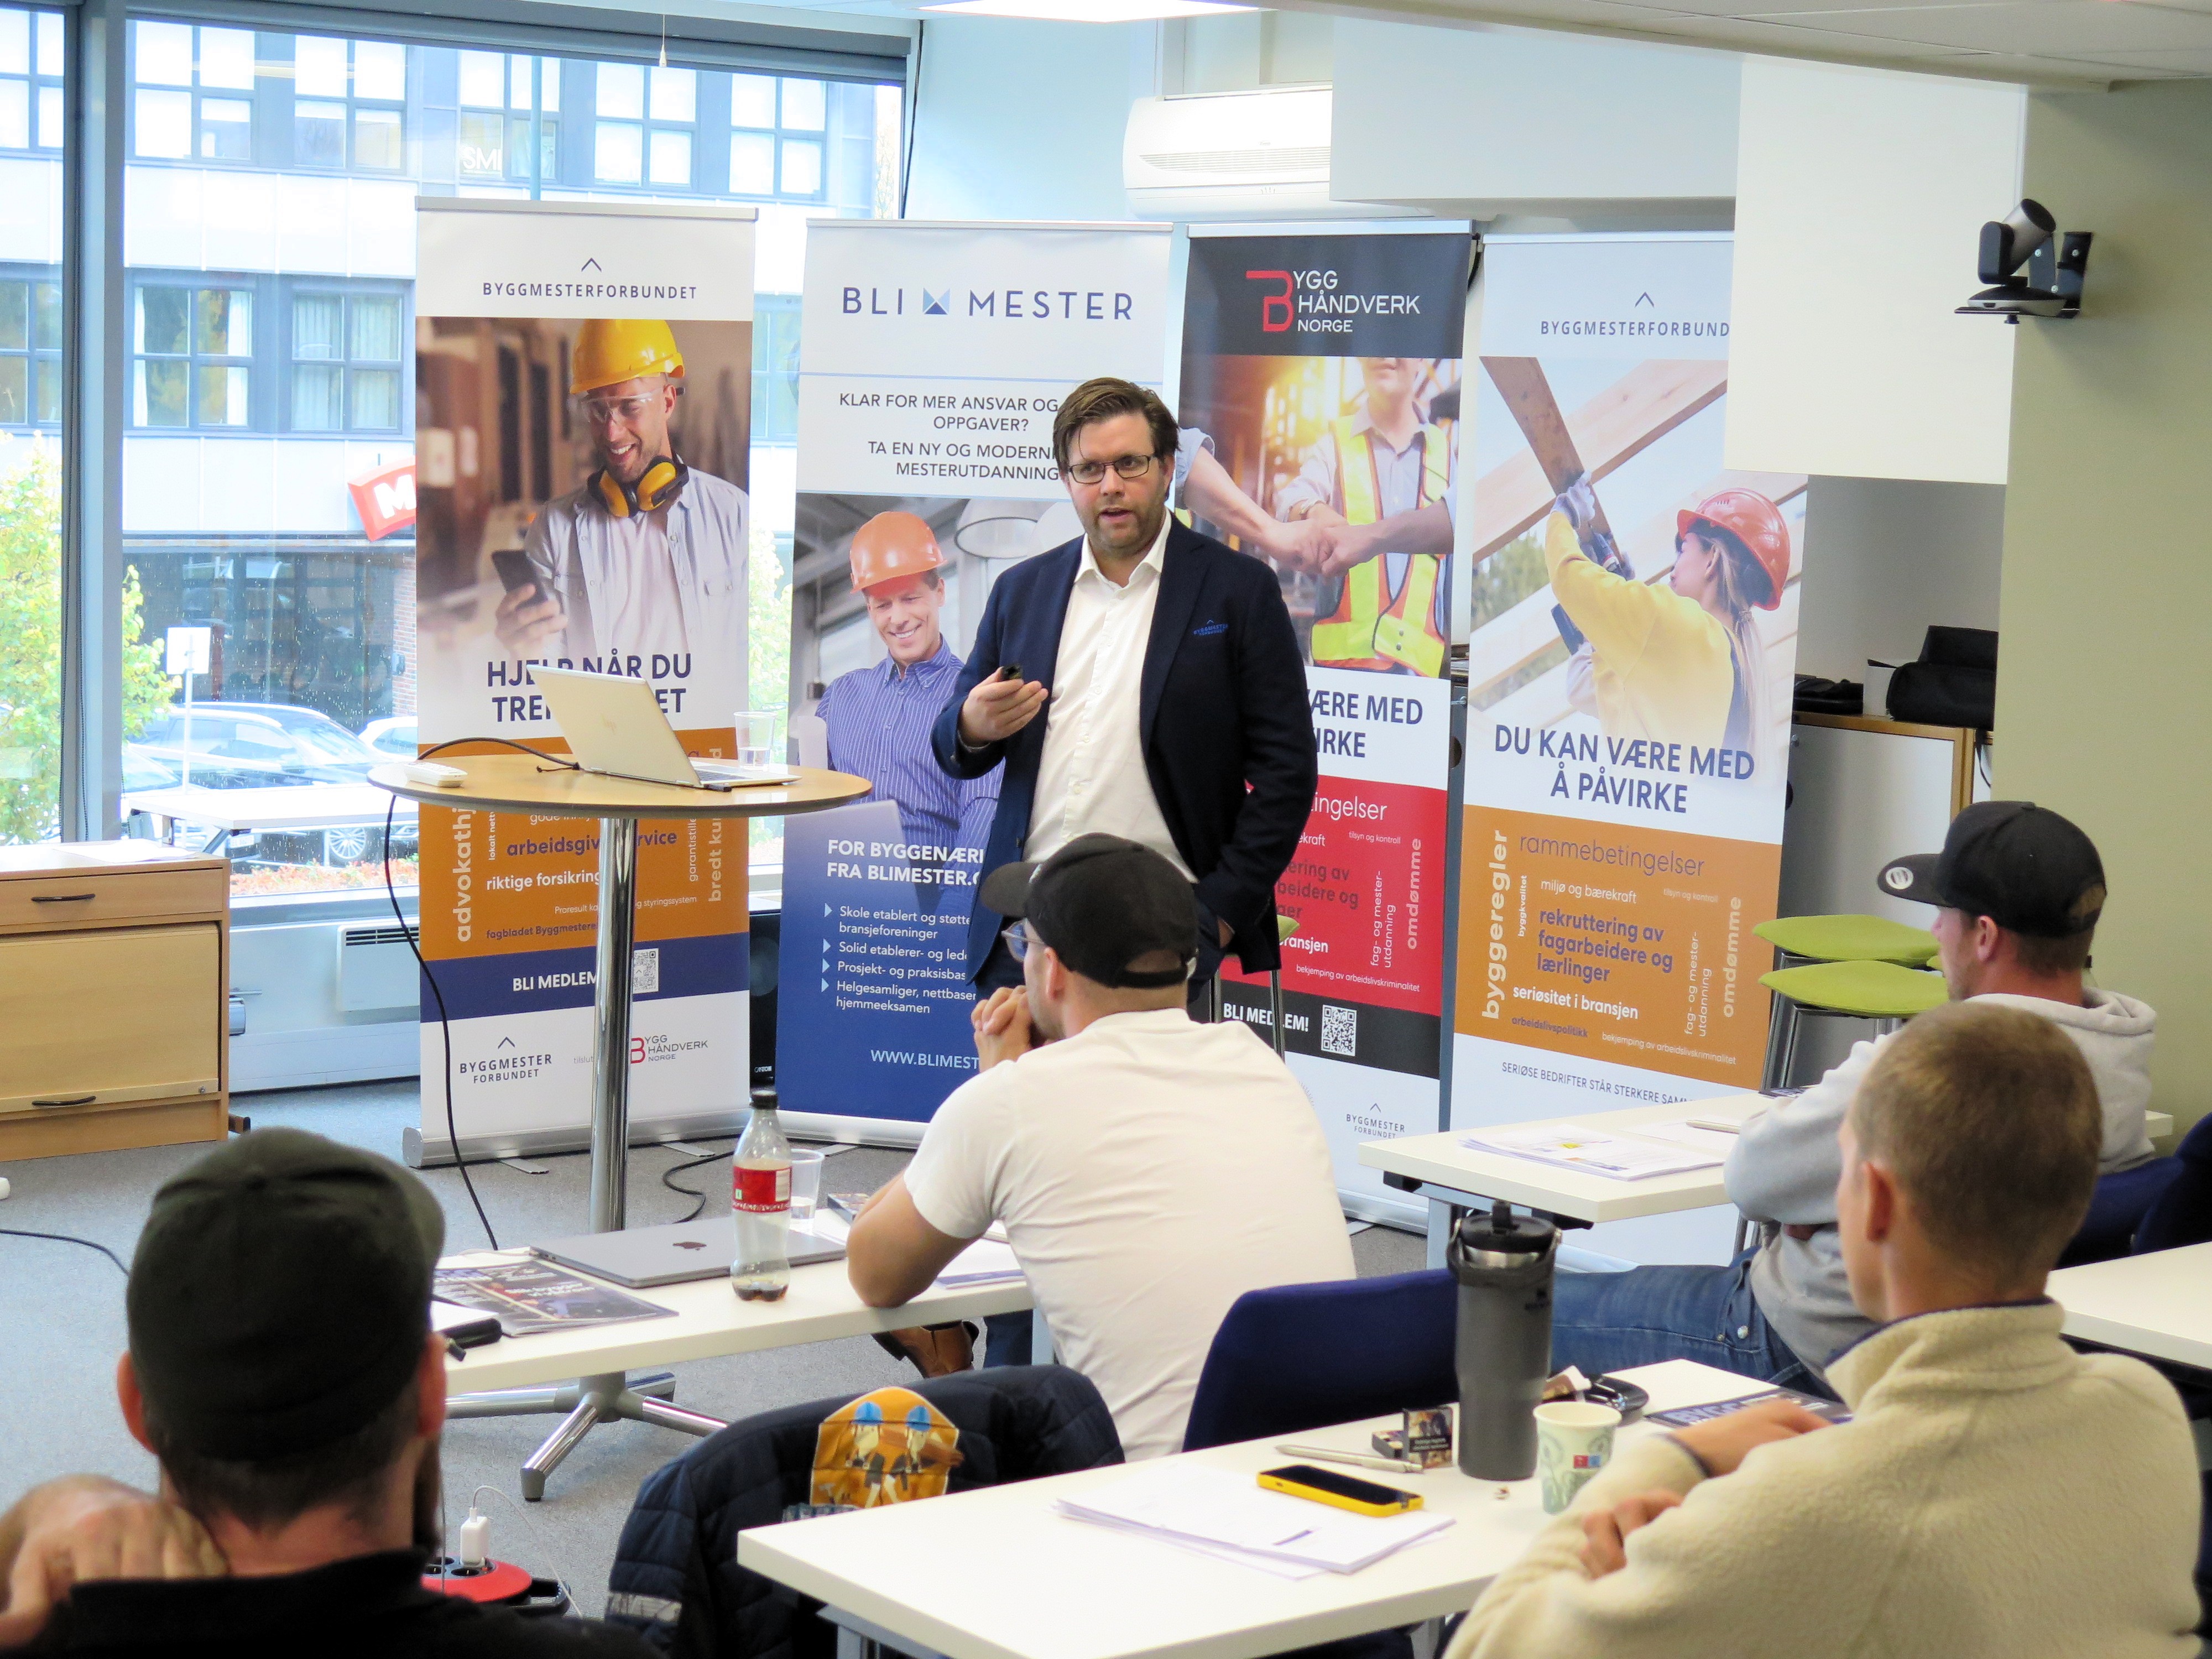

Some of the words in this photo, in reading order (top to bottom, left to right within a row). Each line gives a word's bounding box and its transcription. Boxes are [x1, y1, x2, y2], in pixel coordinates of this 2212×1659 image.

[483, 282, 697, 299] BYGGMESTERFORBUNDET
[843, 287, 903, 315] BLI
[969, 289, 1133, 320] MESTER
[1298, 290, 1420, 314] HÅNDVERK
[1297, 319, 1353, 332] NORGE
[1541, 321, 1729, 337] BYGGMESTERFORBUND
[839, 393, 880, 408] KLAR
[886, 394, 917, 409] FOR
[924, 395, 956, 410] MER
[961, 397, 1027, 411] ANSVAR
[1032, 398, 1058, 412] OG
[933, 416, 1029, 431] OPPGAVER?
[868, 441, 886, 454] TA
[893, 443, 914, 455] EN
[920, 443, 941, 456] NY
[946, 444, 971, 457] OG
[896, 462, 1059, 481] MESTERUTDANNING
[652, 653, 691, 680] DU
[1307, 689, 1359, 719] ÆRE
[1366, 695, 1423, 726] MED
[1496, 724, 1530, 755] DU
[1540, 729, 1598, 763] KAN
[1607, 736, 1682, 773] VÆRE
[1689, 745, 1755, 780] MED
[1550, 761, 1569, 799] Å
[1578, 766, 1688, 813] PÅVIRKE
[1311, 792, 1387, 821] ingelser
[1349, 831, 1364, 841] tilsyn
[1366, 834, 1374, 843] og
[1376, 833, 1401, 844] kontroll
[828, 839, 864, 856] FOR
[1520, 834, 1705, 877] rammebetingelser
[708, 849, 722, 902] bredt
[827, 862, 862, 879] FRA
[1332, 867, 1349, 880] av
[487, 875, 533, 891] riktige
[1541, 878, 1566, 895] miljø
[1568, 885, 1582, 899] og
[1584, 886, 1637, 905] bærekraft
[1339, 891, 1359, 910] og
[1374, 870, 1383, 917] mester-
[1406, 838, 1421, 950] omdømme
[1663, 888, 1681, 900] tilsyn
[1682, 891, 1691, 901] og
[1693, 891, 1718, 902] kontroll
[555, 904, 587, 914] Proresult
[644, 896, 697, 907] styringssystem
[1518, 875, 1527, 937] byggkvalitet
[839, 906, 870, 919] Skole
[873, 909, 917, 922] etablert
[921, 914, 936, 925] og
[1482, 830, 1511, 1019] byggeregler
[1540, 908, 1639, 942] rekruttering
[1642, 926, 1665, 941] av
[487, 927, 533, 940] fagbladet
[535, 922, 599, 937] Byggmestere
[839, 922, 938, 941] bransjeforeninger
[1374, 920, 1383, 937] og
[1383, 905, 1396, 968] utdanning
[839, 942, 867, 954] Solid
[870, 945, 924, 958] etablerer-
[927, 950, 943, 962] og
[1538, 930, 1647, 965] fagarbeidere
[1651, 952, 1673, 973] og
[1689, 931, 1698, 983] mester-
[1723, 897, 1742, 1018] omdømme
[838, 961, 886, 975] Prosjekt-
[889, 966, 904, 977] og
[1296, 964, 1334, 980] bekjemping
[1345, 973, 1420, 992] arbeidslivskriminalitet
[1537, 953, 1610, 984] lærlinger
[513, 978, 534, 992] BLI
[539, 971, 596, 989] MEDLEM
[1513, 985, 1571, 1007] seriøsitet
[1574, 994, 1578, 1008] i
[1581, 995, 1639, 1020] bransjen
[1688, 985, 1697, 1003] og
[1699, 968, 1712, 1037] utdanning
[836, 995, 930, 1013] hjemmeeksamen
[1223, 1003, 1244, 1020] BLI
[1246, 1006, 1309, 1032] MEDEM!
[1512, 1016, 1588, 1038] arbeidslivspolitikk
[648, 1040, 708, 1053] HÅNDVERK
[1602, 1032, 1644, 1048] bekjemping
[1646, 1041, 1655, 1050] av
[1657, 1042, 1736, 1065] arbeidslivskriminalitet
[460, 1054, 552, 1073] BYGGMESTER
[648, 1053, 676, 1062] NORGE
[871, 1050, 979, 1069] WWW.BLIMEST
[473, 1068, 539, 1083] FORBUNDET
[1502, 1061, 1538, 1079] SERIØSE
[1541, 1069, 1587, 1088] BEDRIFTER
[1589, 1078, 1611, 1093] STÅR
[1614, 1084, 1659, 1102] STERKERE
[1346, 1114, 1405, 1133] BYGGMESTER
[1354, 1125, 1396, 1139] FORBUNDET
